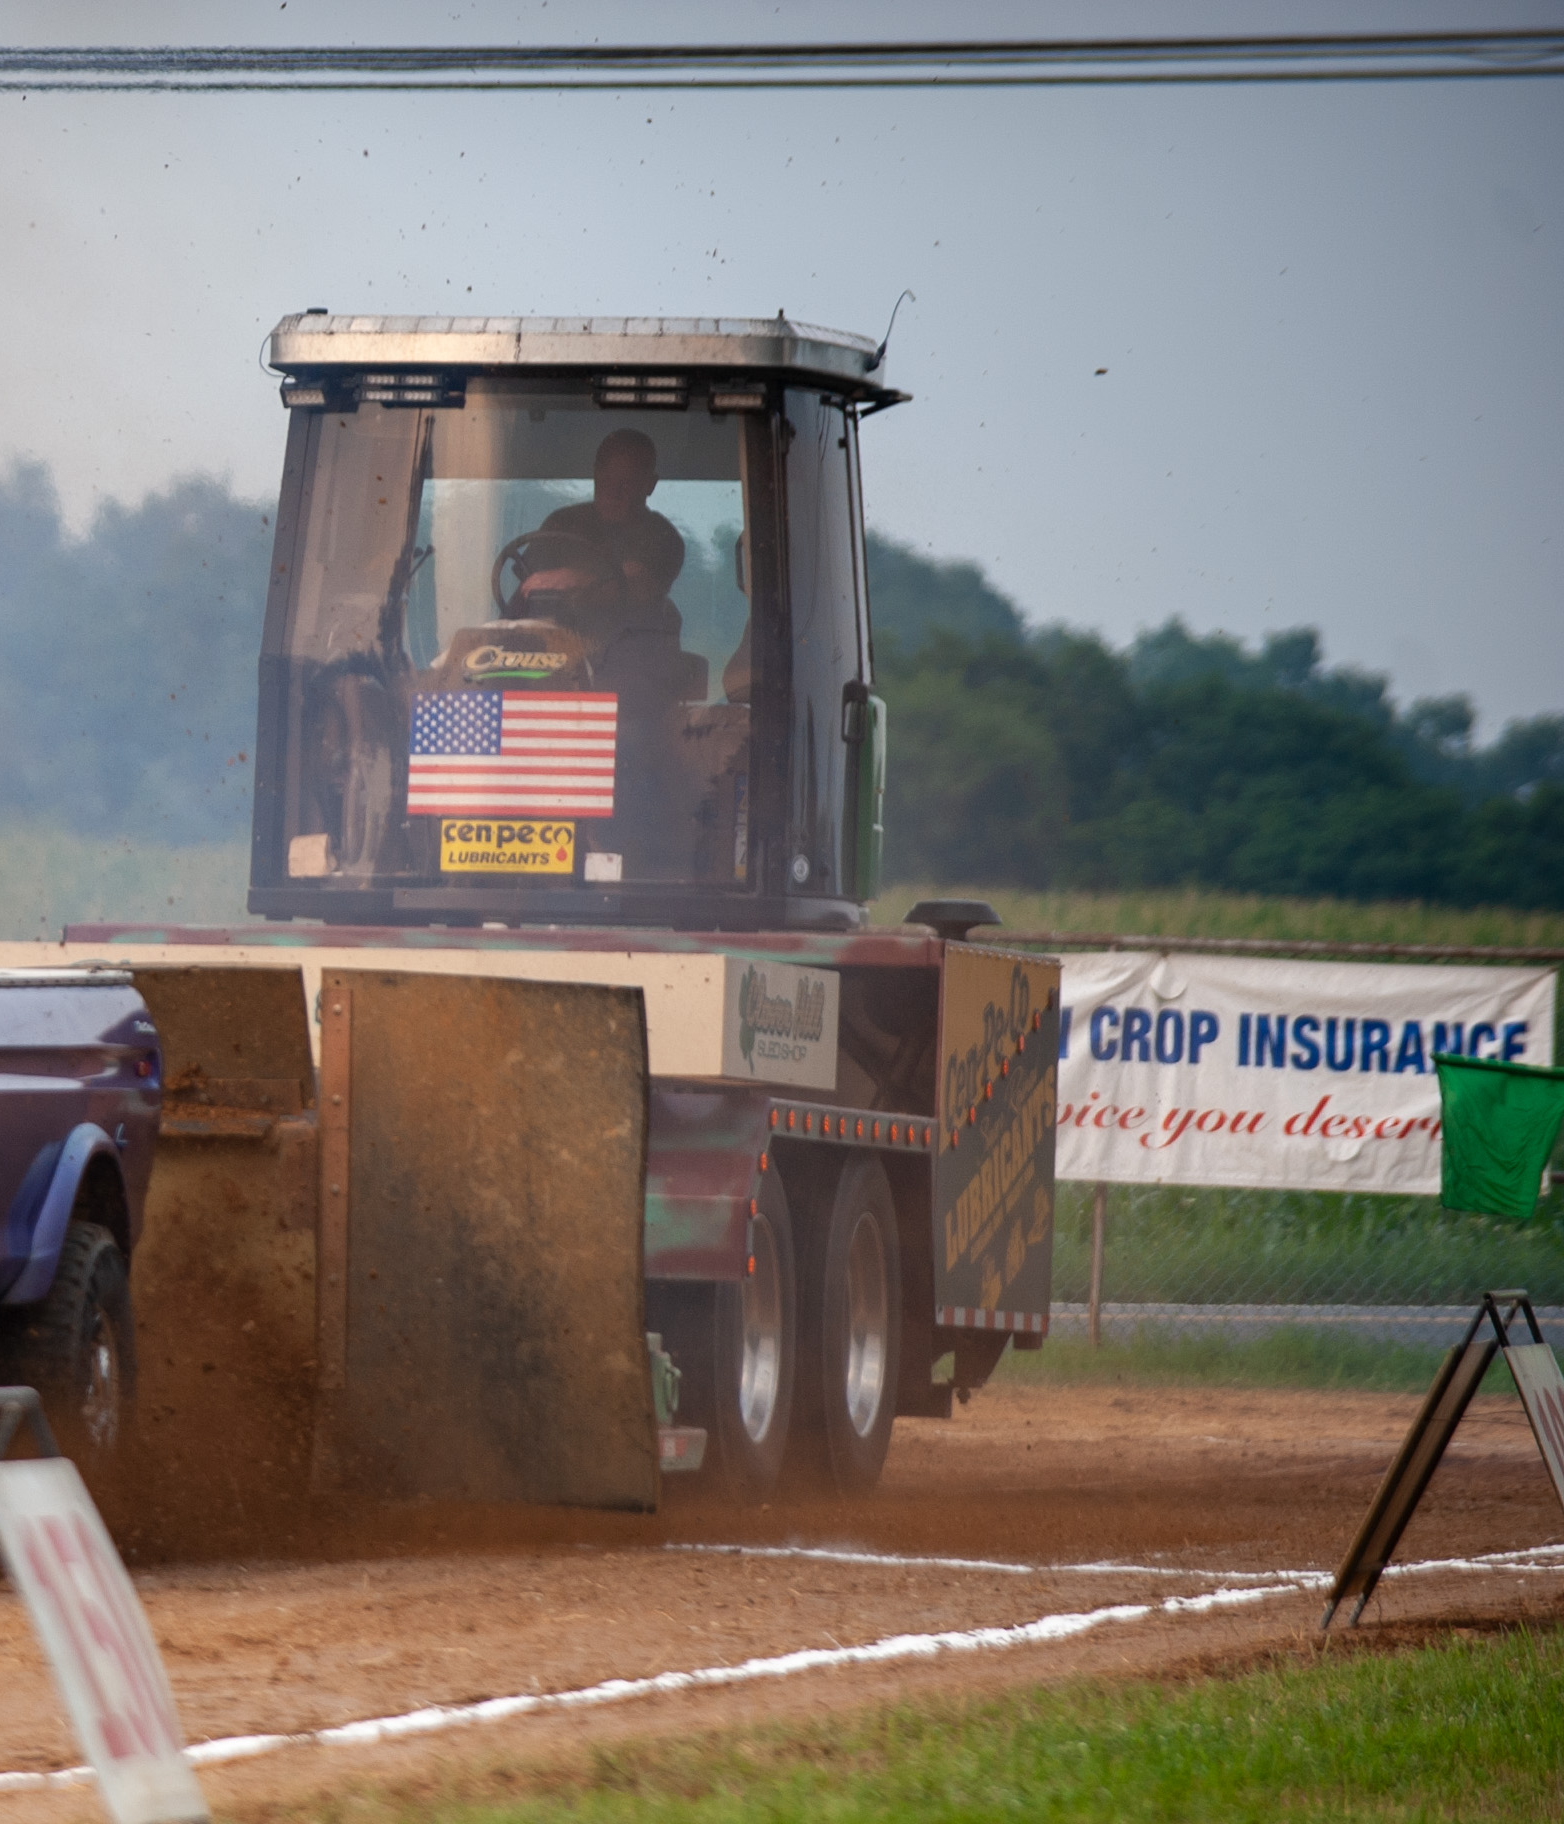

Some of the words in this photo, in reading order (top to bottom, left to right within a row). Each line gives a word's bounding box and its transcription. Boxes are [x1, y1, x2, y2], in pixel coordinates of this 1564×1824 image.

[447, 851, 551, 865] LUBRICANTS
[1090, 1005, 1220, 1064] CROP
[1238, 1012, 1529, 1075] INSURANCE
[1139, 1106, 1270, 1151] you
[945, 1063, 1055, 1273] LUBRICANTS
